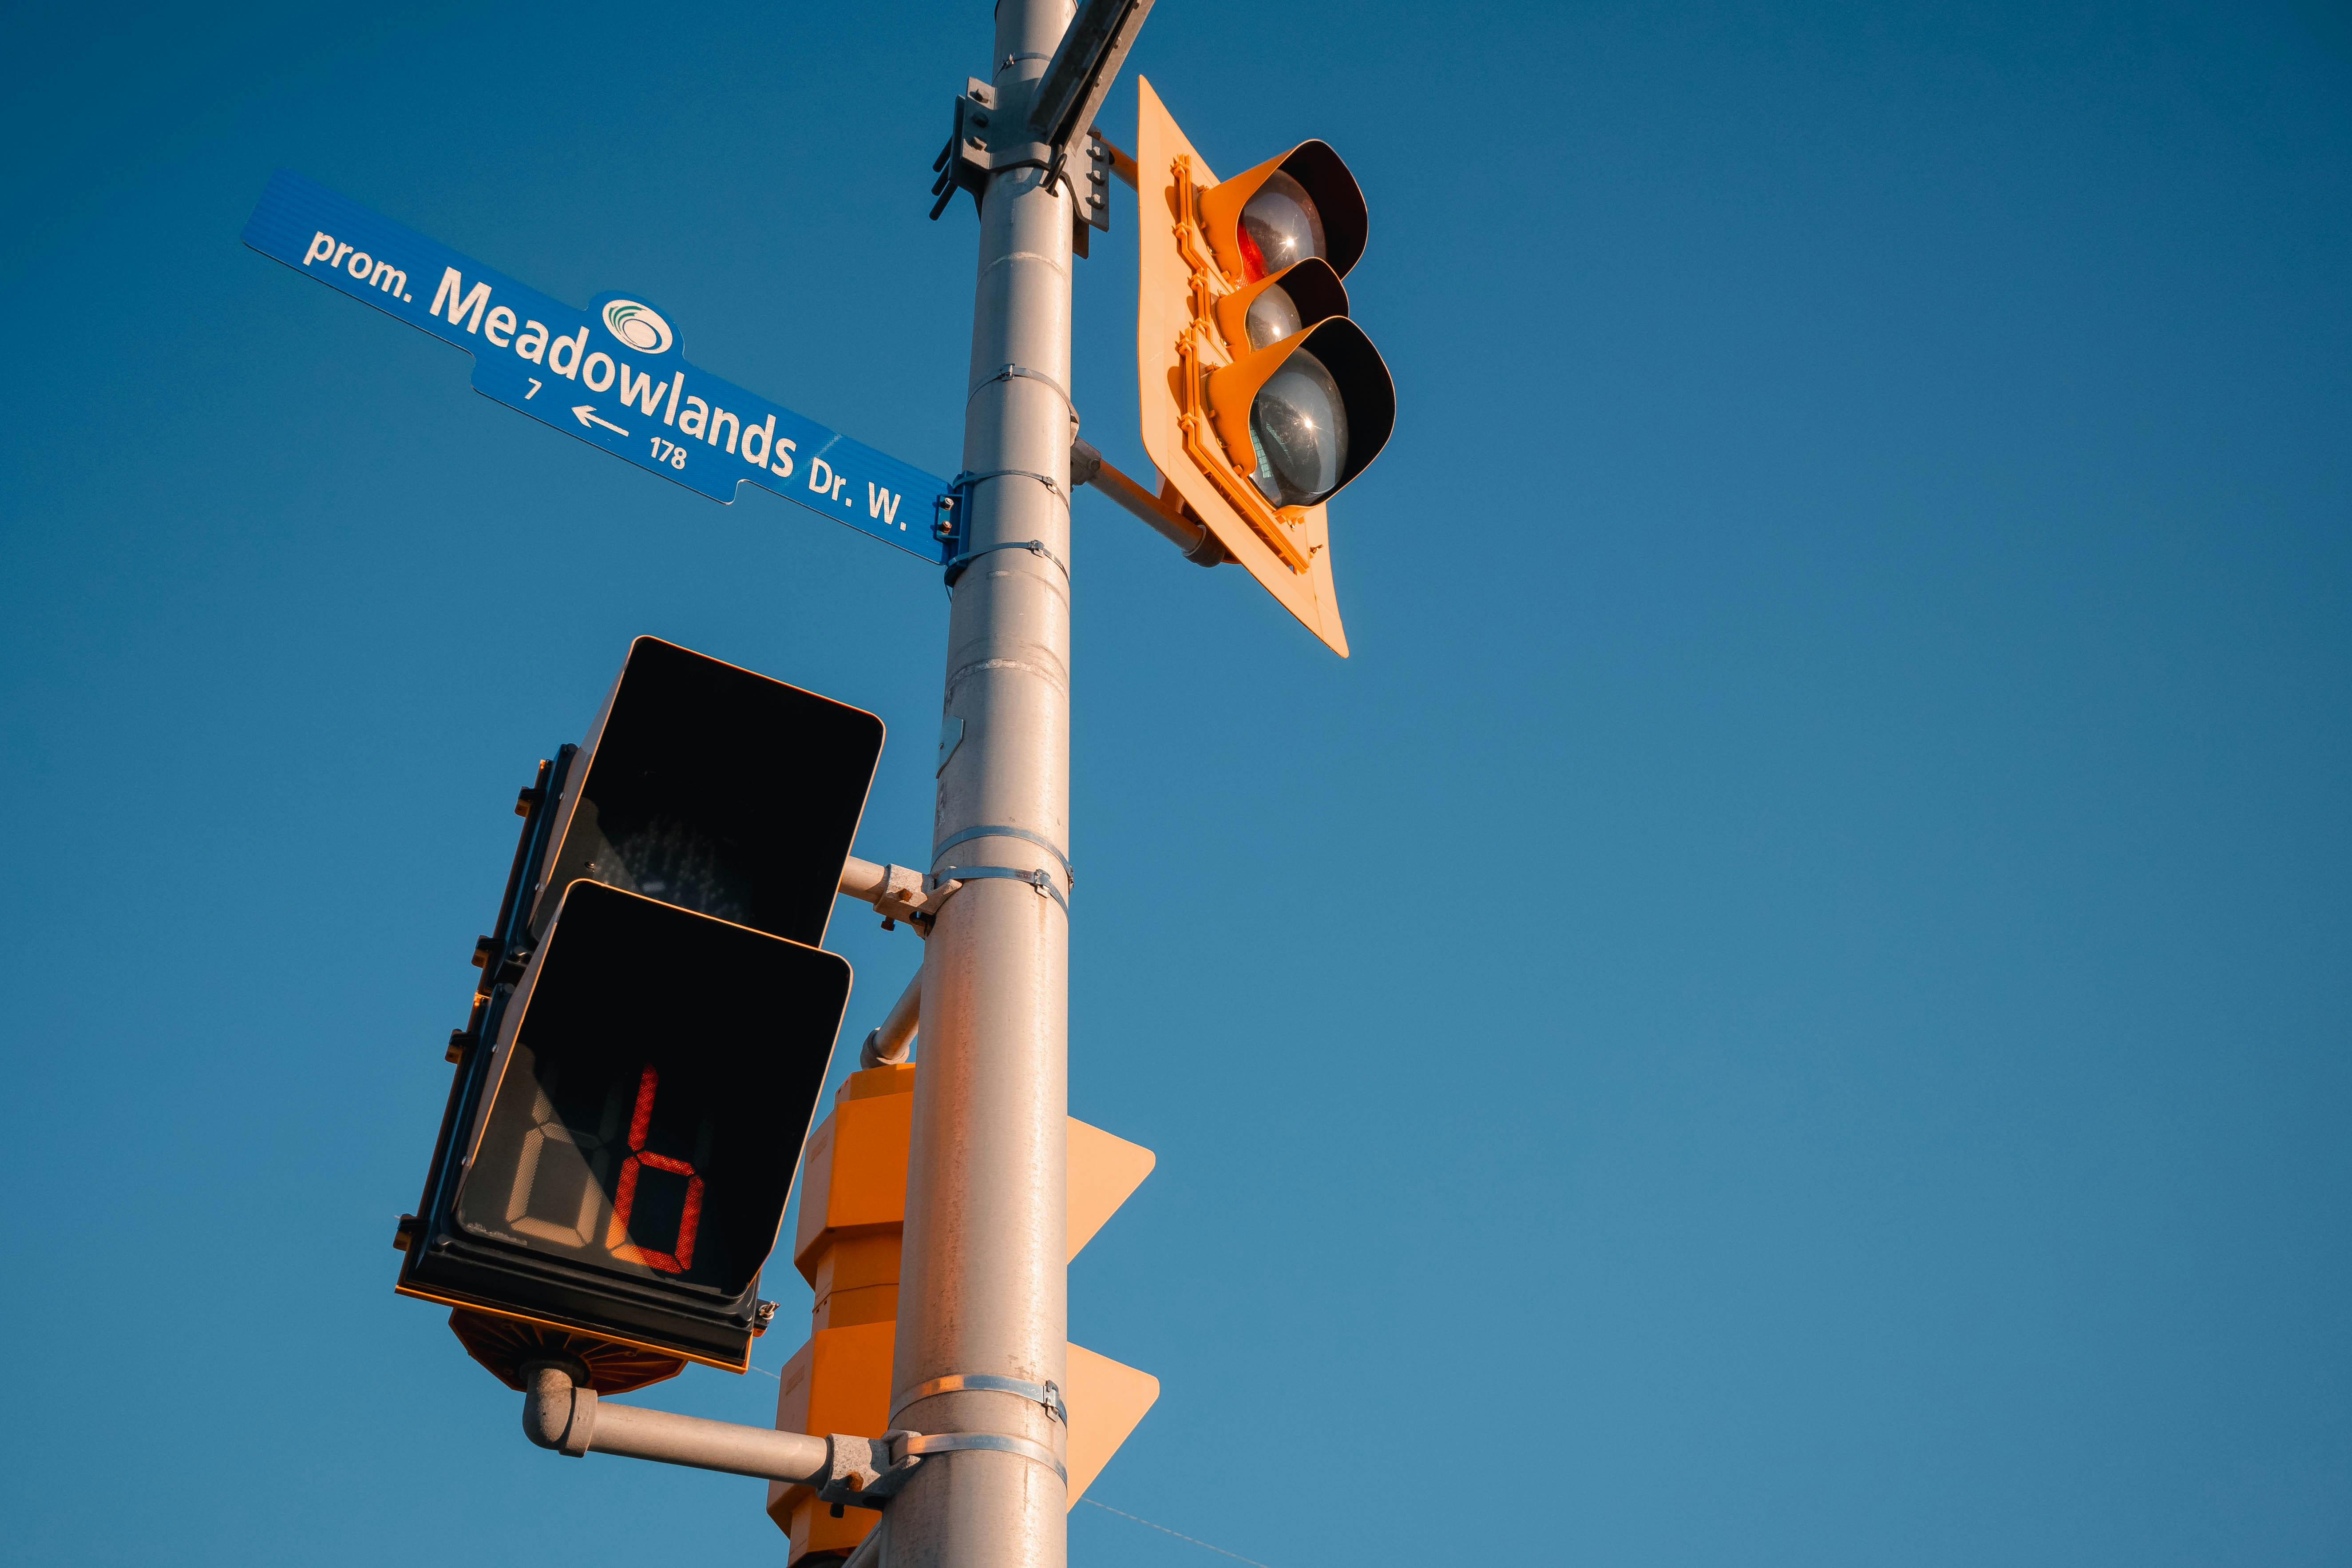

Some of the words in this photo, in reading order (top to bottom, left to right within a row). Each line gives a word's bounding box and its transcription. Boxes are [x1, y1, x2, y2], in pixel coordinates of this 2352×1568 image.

[303, 230, 412, 303] prom.
[429, 266, 796, 478] Meadowlands
[808, 457, 852, 507] Dr.
[868, 482, 907, 531] W.
[524, 377, 542, 400] 7
[650, 436, 687, 470] 178
